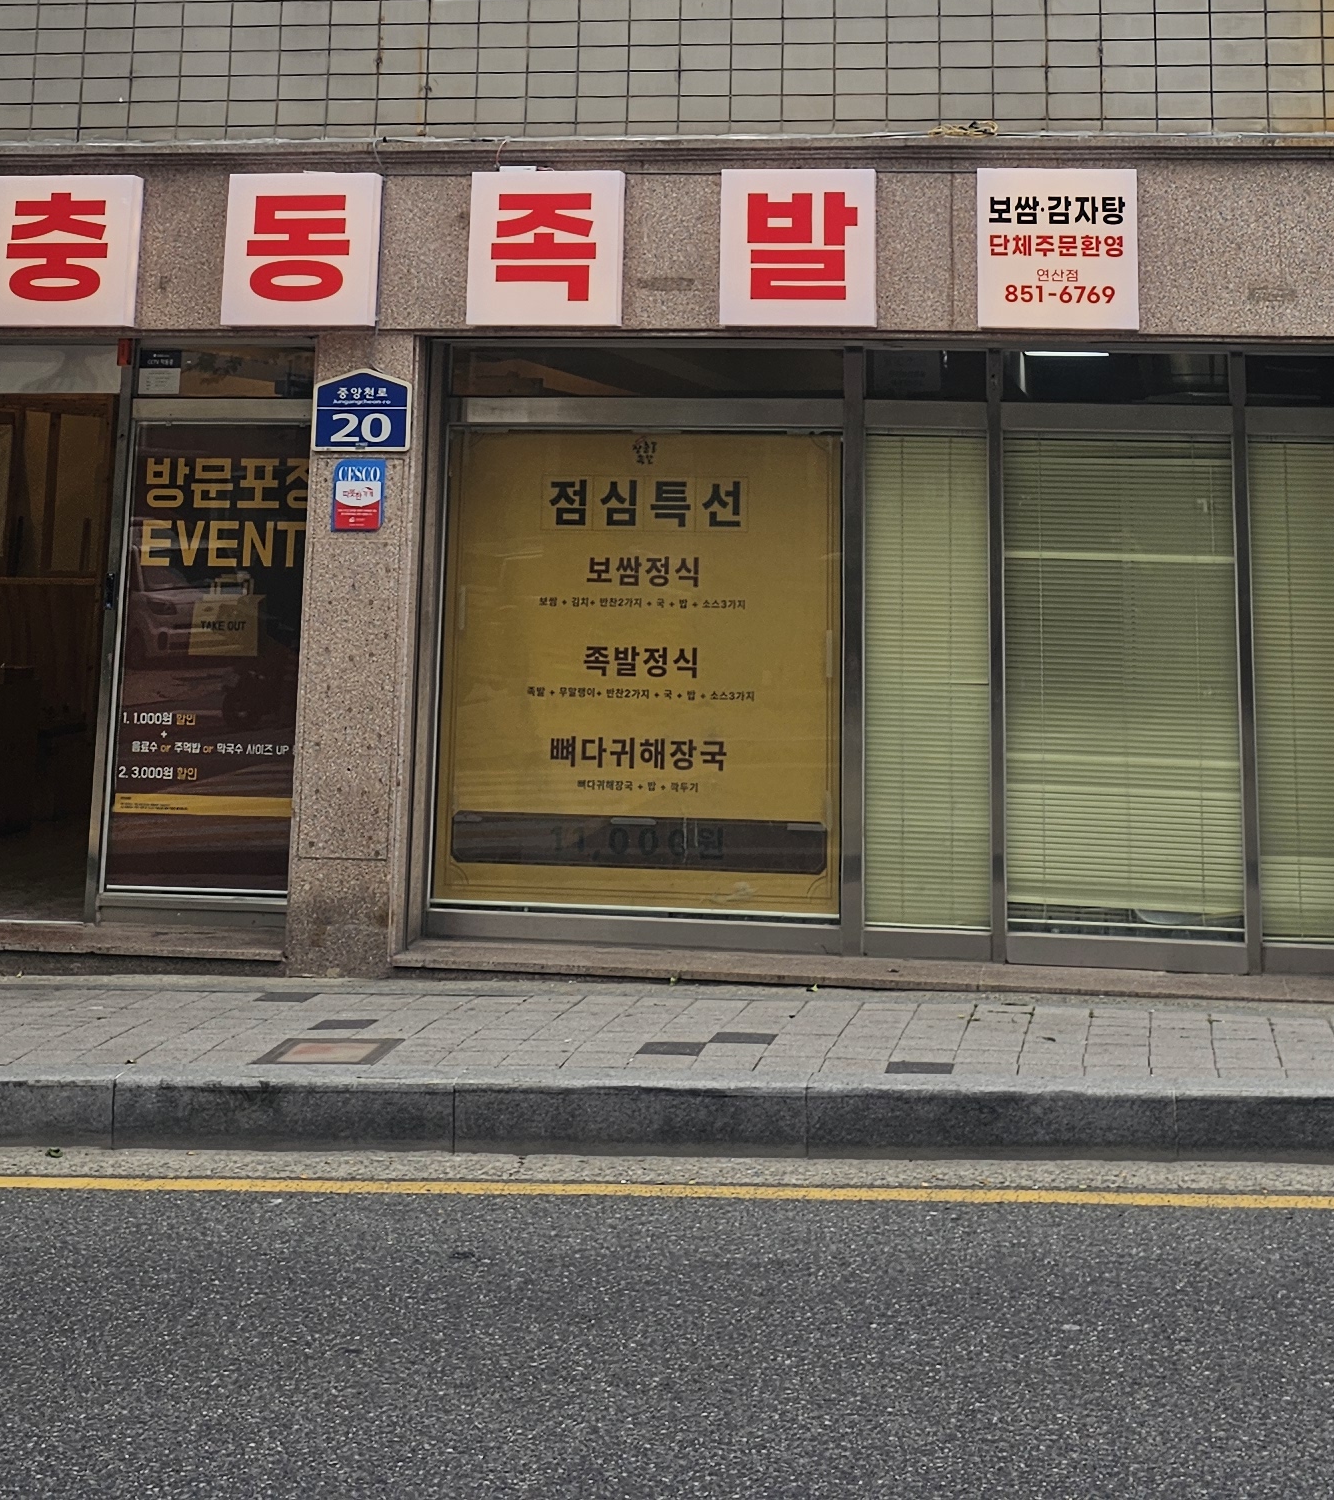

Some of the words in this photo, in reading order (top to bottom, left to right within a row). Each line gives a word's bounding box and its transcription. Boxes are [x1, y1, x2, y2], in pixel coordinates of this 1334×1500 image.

[989, 235, 1123, 257] 단체주문환영
[1037, 268, 1078, 282] 연산점
[1005, 285, 1115, 303] 851-6769
[337, 387, 388, 399] 중앙천로
[330, 413, 392, 443] 20
[338, 466, 381, 481] CESCO
[549, 479, 742, 528] 점심특선
[140, 520, 306, 567] EVENT
[586, 556, 700, 588] 보쌈정식
[201, 620, 225, 631] TAKE
[227, 621, 246, 631] OUT
[583, 646, 698, 679] 족발정식
[160, 745, 171, 753] or
[550, 735, 728, 772] 뼈다귀해장국
